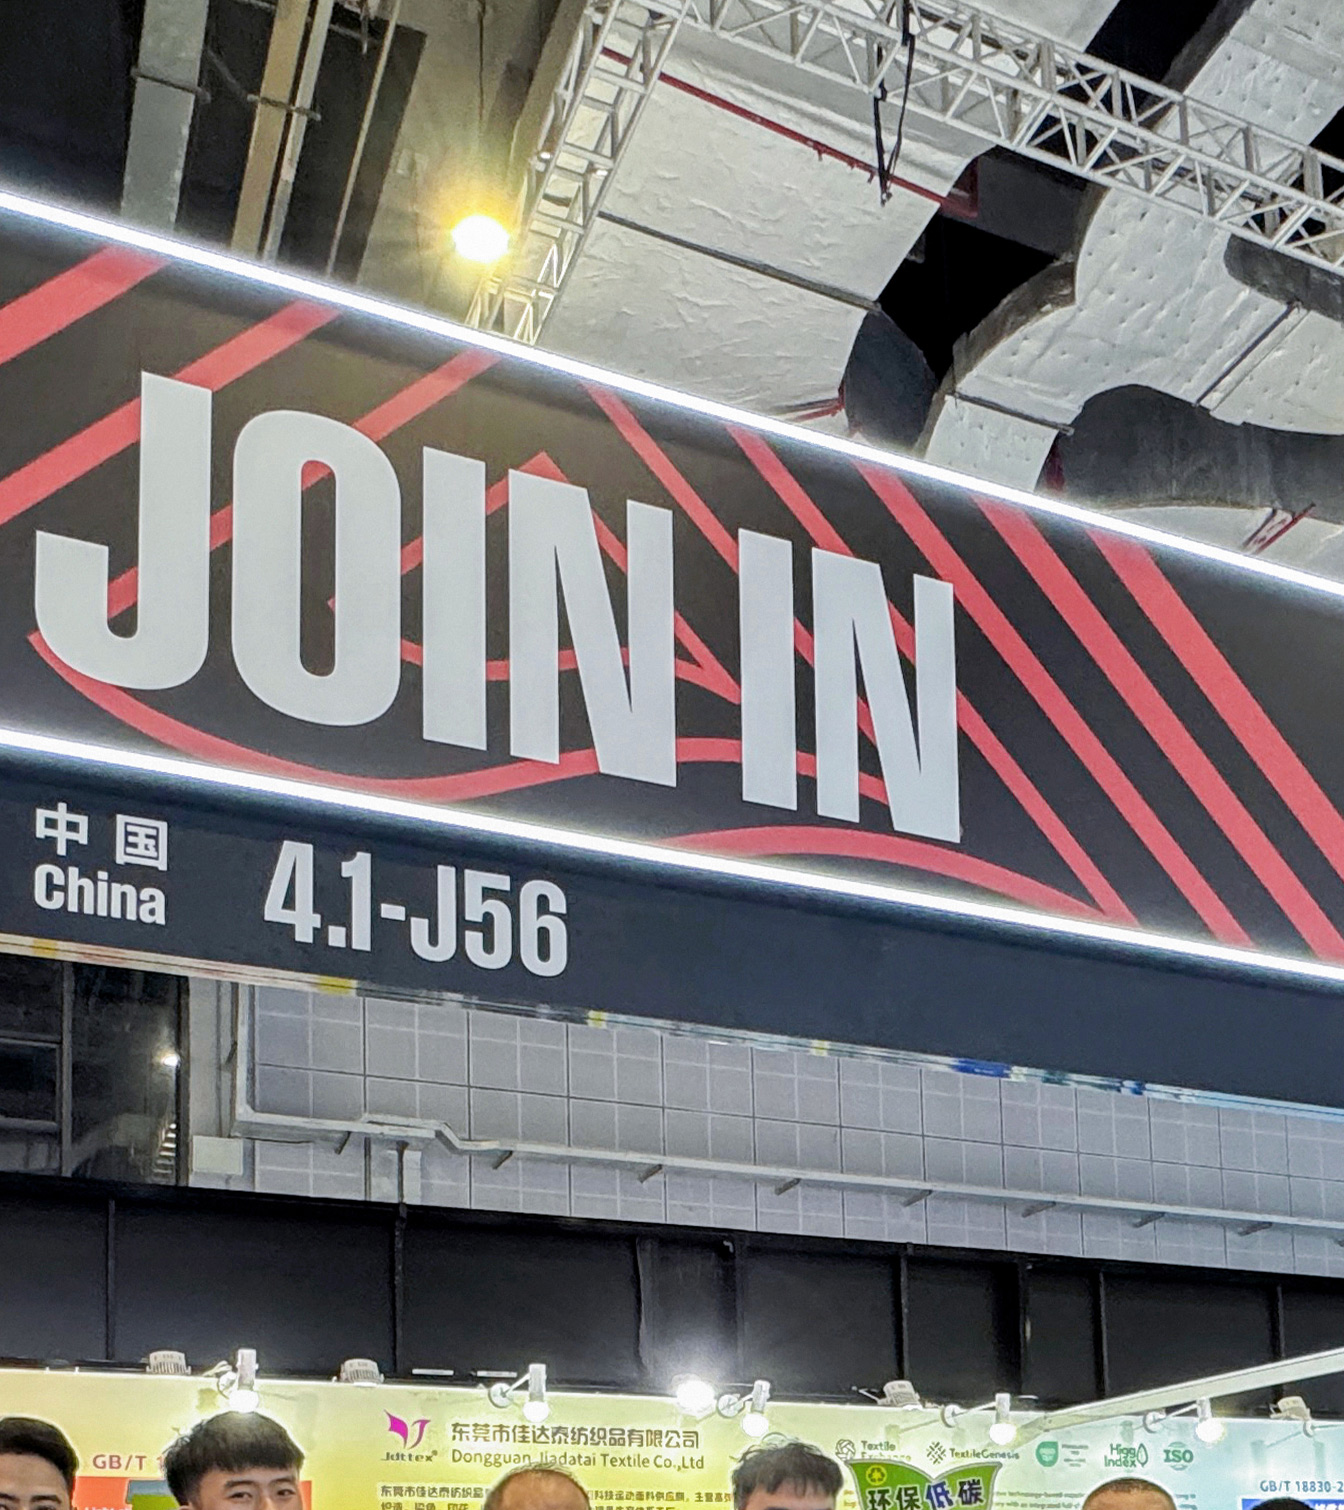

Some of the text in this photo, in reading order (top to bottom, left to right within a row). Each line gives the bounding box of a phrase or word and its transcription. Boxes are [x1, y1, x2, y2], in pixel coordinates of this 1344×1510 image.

[34, 371, 960, 844] JOIN IN
[33, 863, 167, 927] China
[263, 839, 569, 978] 4.1-J56
[451, 1422, 700, 1450] 东莞市佳达泰纺织品有限公司
[861, 1441, 896, 1452] Textile
[1110, 1443, 1136, 1459] Higg
[93, 1454, 147, 1470] GB/T
[452, 1449, 531, 1469] Dongguan
[601, 1453, 650, 1469] Textile
[1104, 1455, 1137, 1468] Index
[1163, 1449, 1194, 1463] ISO
[1260, 1480, 1291, 1493] GB/T
